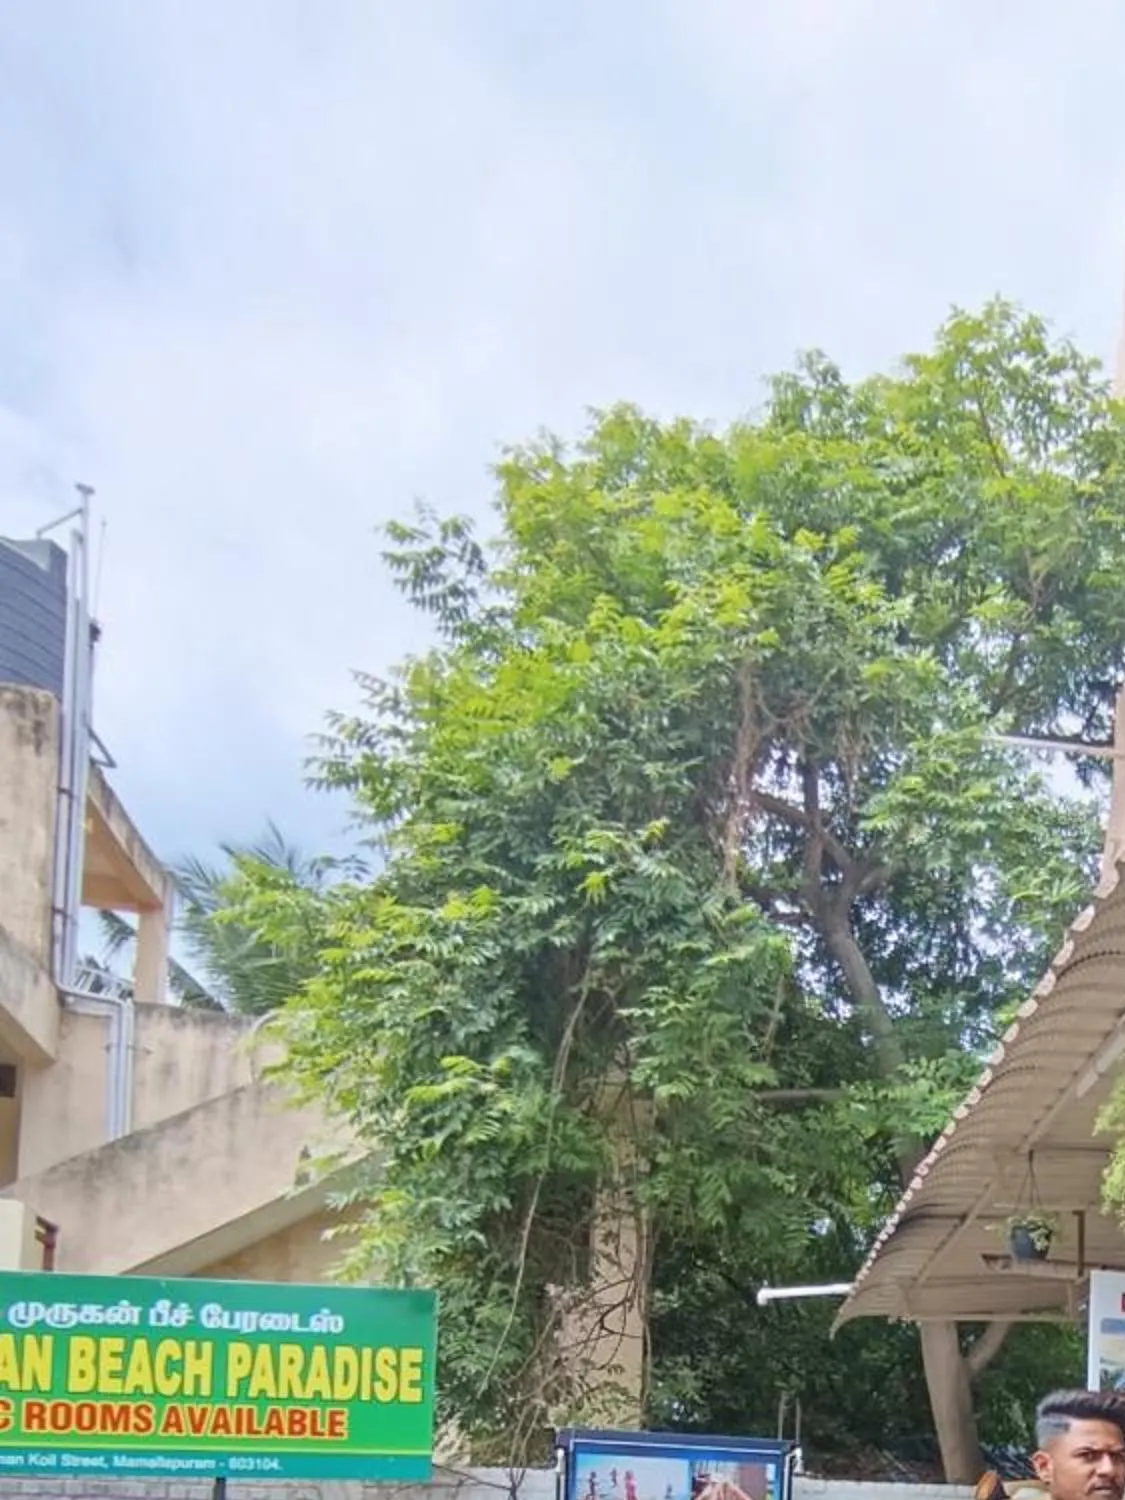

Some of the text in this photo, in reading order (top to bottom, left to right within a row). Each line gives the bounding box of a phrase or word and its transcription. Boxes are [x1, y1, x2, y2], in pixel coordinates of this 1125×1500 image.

[8, 1299, 344, 1334] முருகன் பீச் பேரடைஸ்
[0, 1334, 423, 1403] AN BEACH PARADISE
[23, 1400, 155, 1435] ROOMS
[160, 1404, 349, 1440] AVAILABLE
